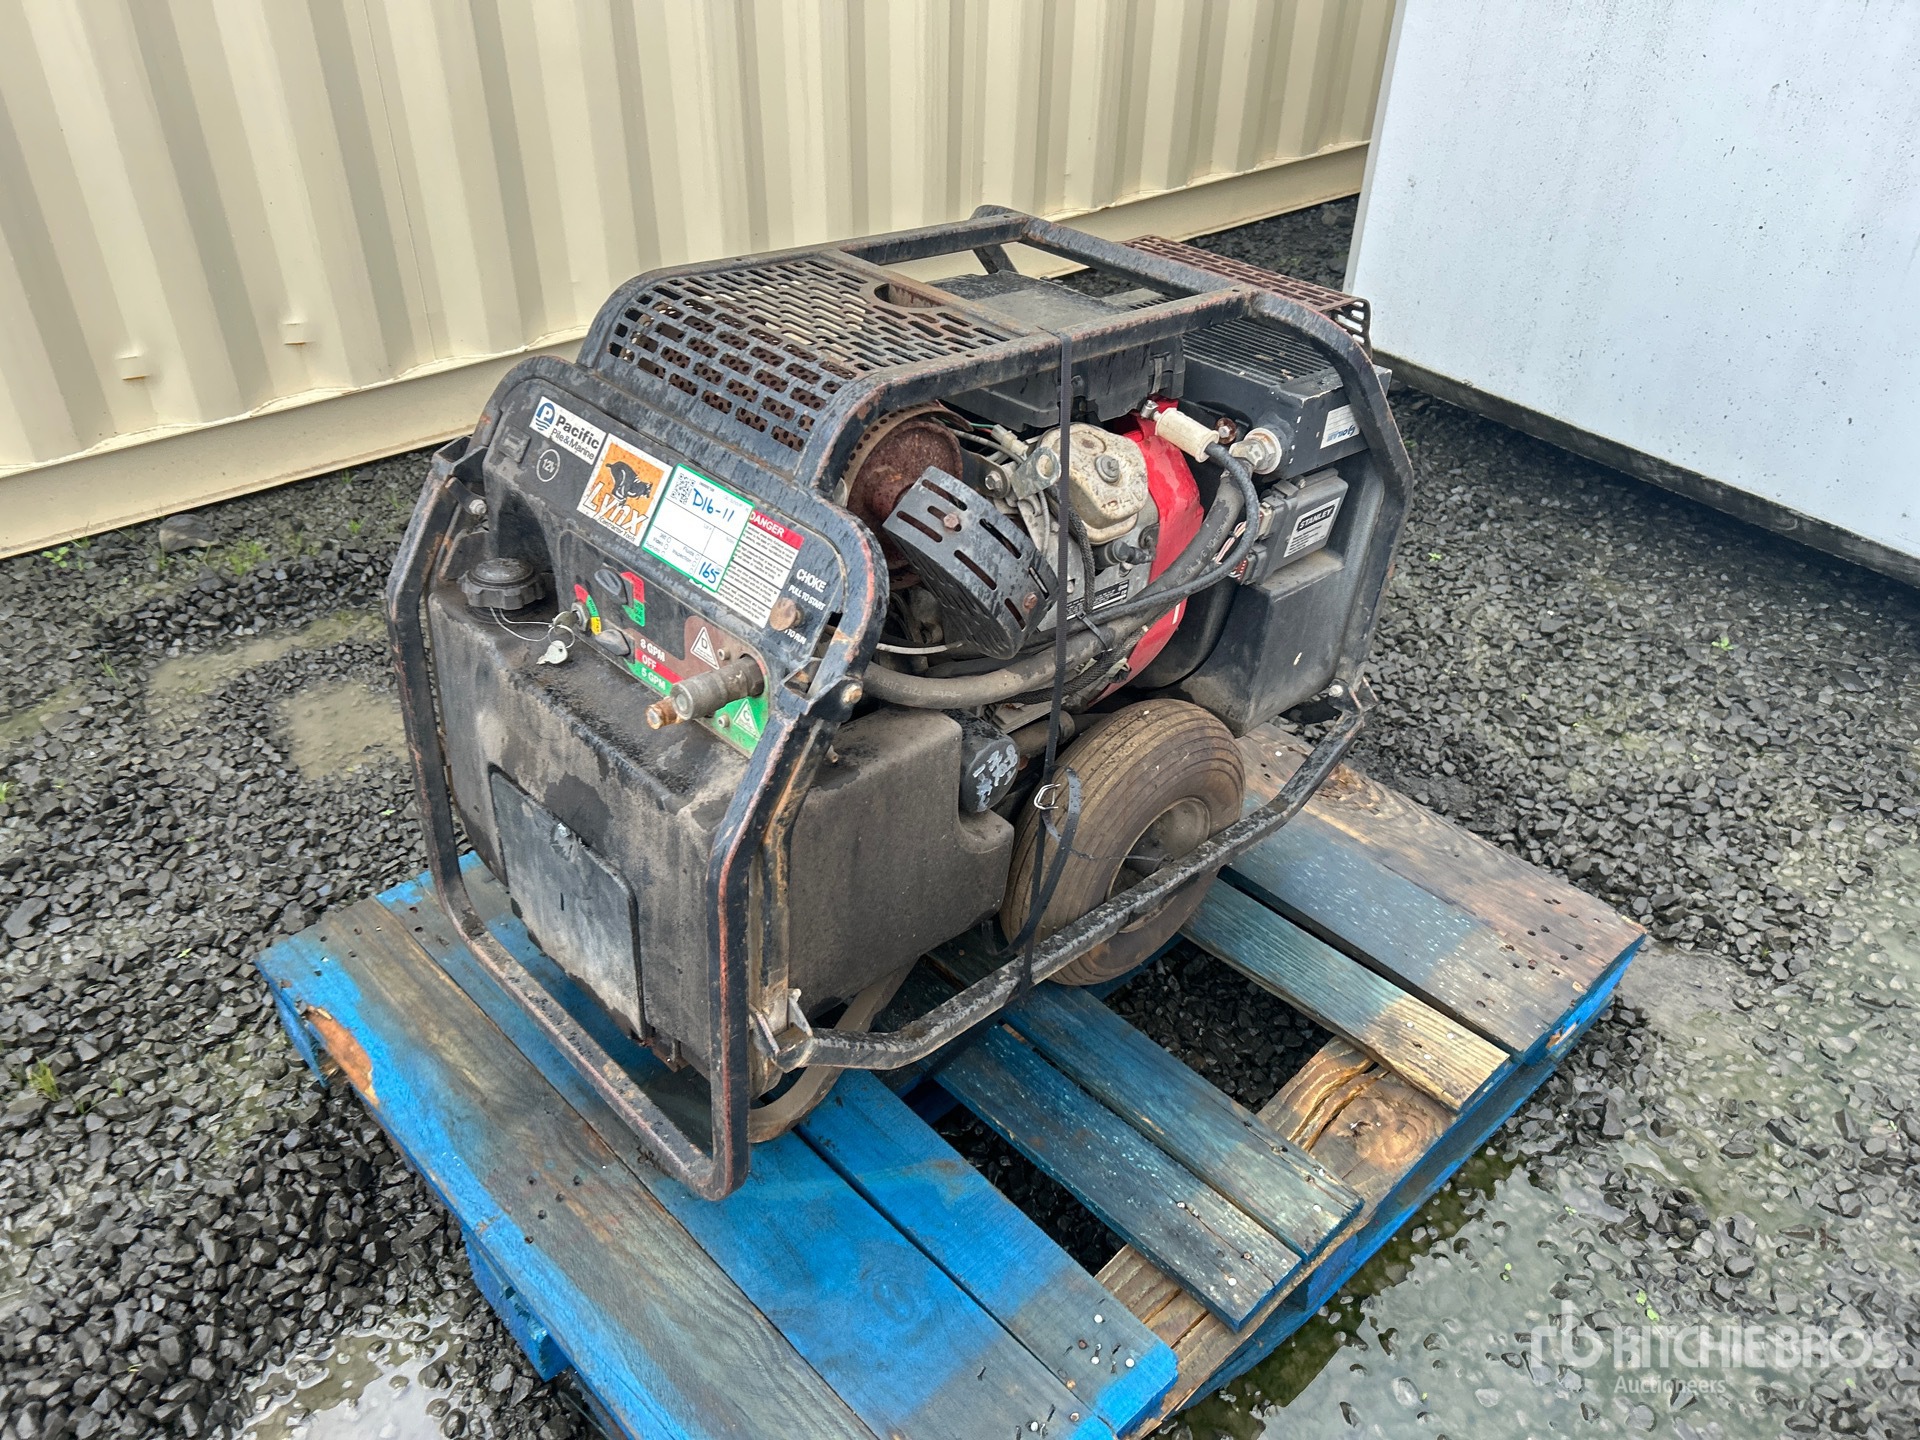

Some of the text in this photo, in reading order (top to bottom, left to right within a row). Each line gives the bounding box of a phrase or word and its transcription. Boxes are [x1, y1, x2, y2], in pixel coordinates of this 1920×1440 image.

[551, 428, 595, 460] Pile&Marine
[556, 415, 600, 450] Pacific
[583, 480, 649, 536] Lynx
[692, 487, 735, 522] D16-11
[1299, 504, 1335, 530] STANLEY
[622, 531, 636, 542] Tools
[749, 511, 785, 537] DANGER
[698, 561, 721, 584] 165
[796, 568, 827, 593] CHOKE
[788, 584, 827, 611] PULL TO START
[787, 628, 796, 638] TO
[642, 654, 657, 670] OFF
[647, 642, 666, 662] GPM
[648, 671, 666, 690] GPM
